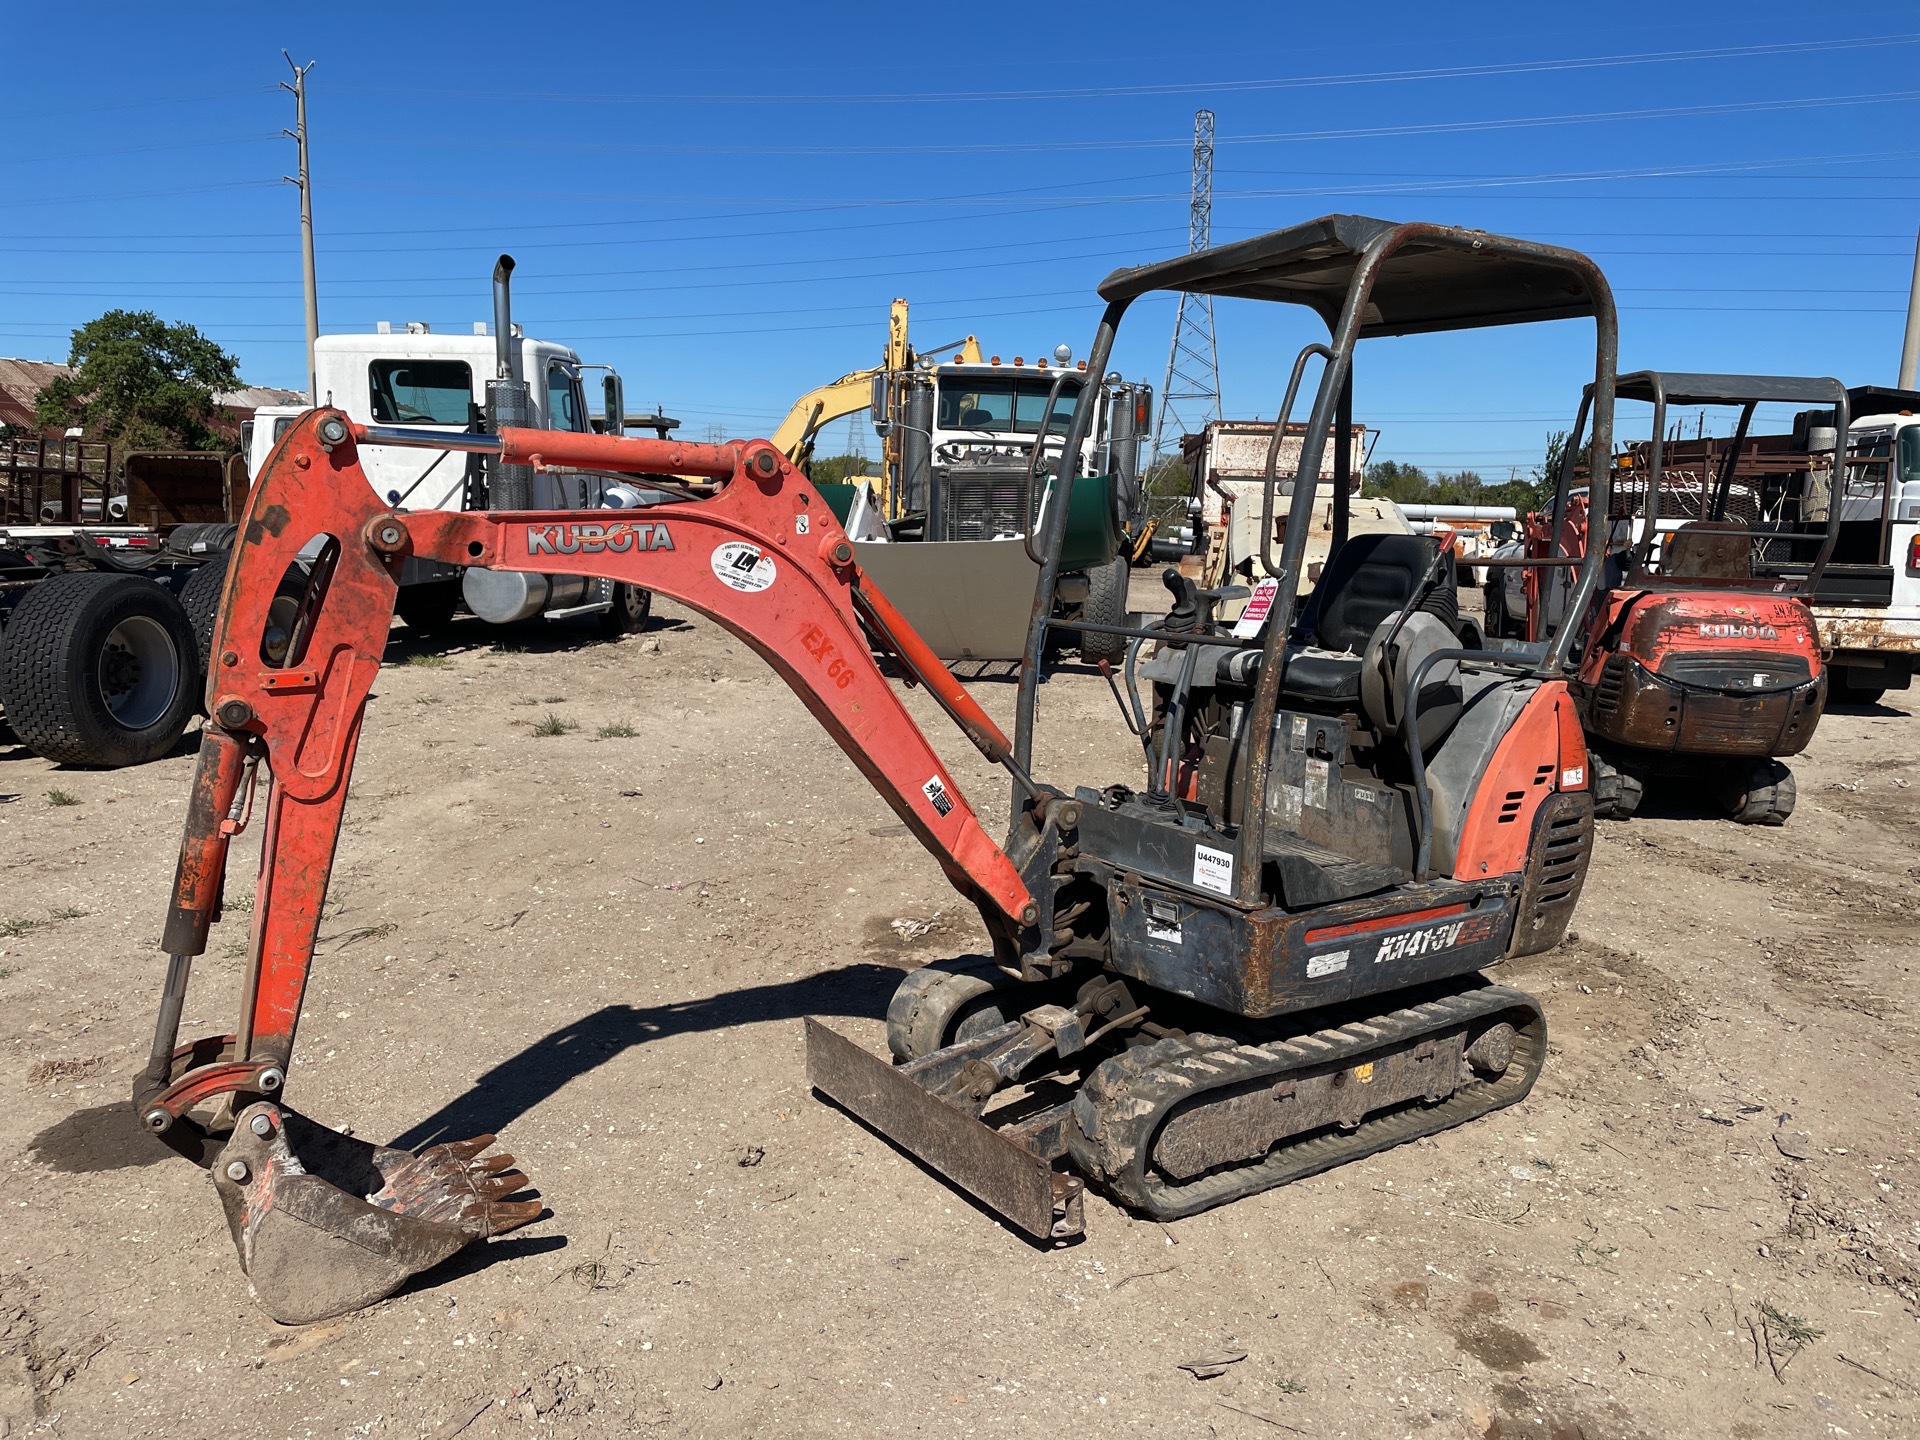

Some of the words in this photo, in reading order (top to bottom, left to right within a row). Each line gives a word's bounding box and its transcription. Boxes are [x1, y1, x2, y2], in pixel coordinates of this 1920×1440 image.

[527, 523, 676, 555] KUBOTA
[800, 625, 834, 664] EX
[1699, 623, 1779, 641] KUBOTA
[827, 658, 855, 689] 66
[1197, 851, 1231, 868] U447930
